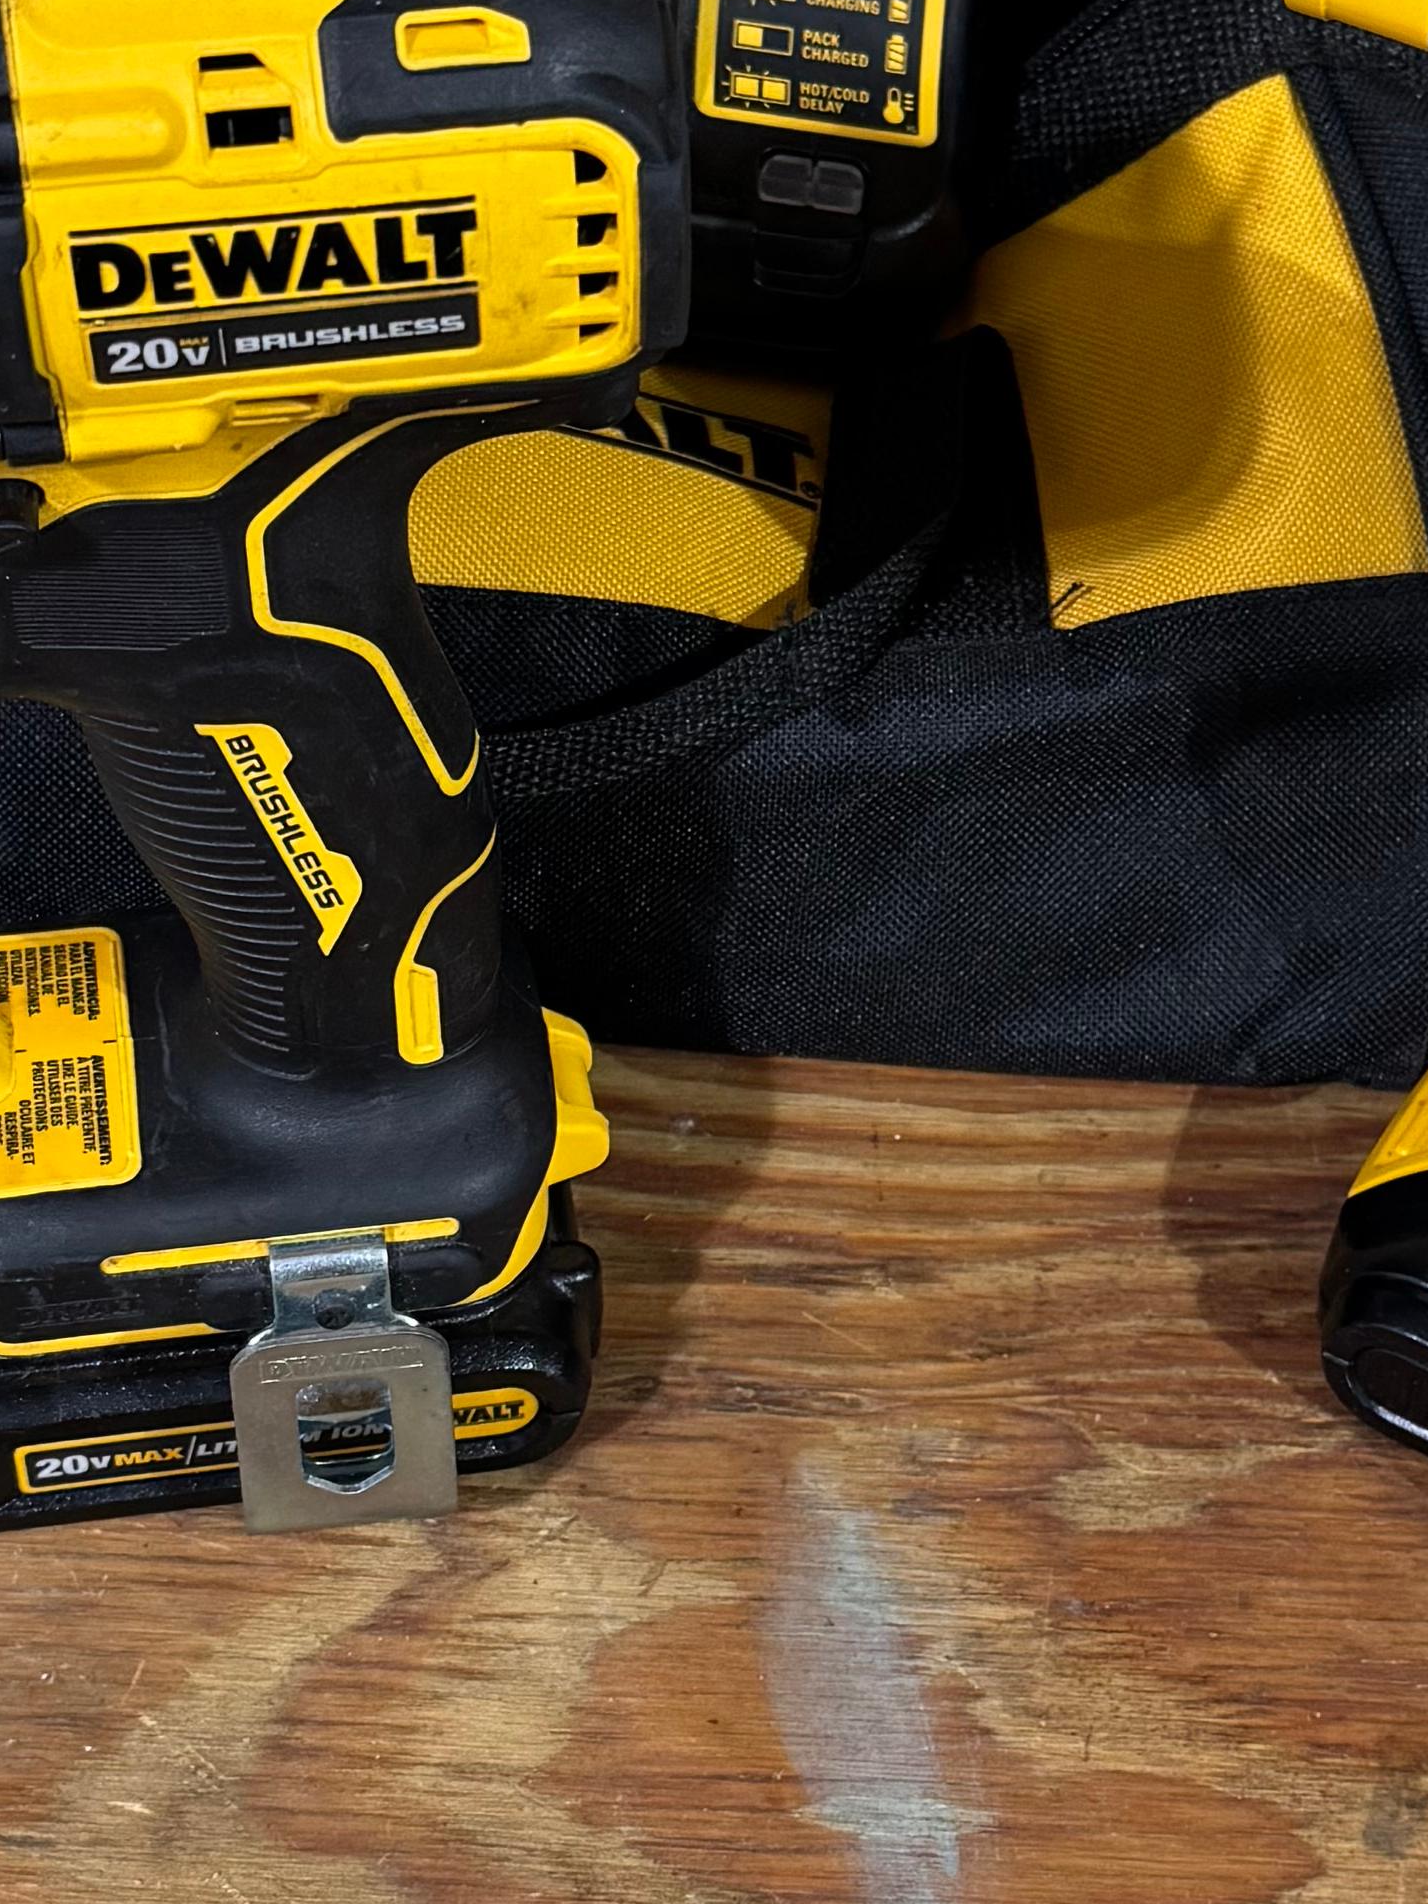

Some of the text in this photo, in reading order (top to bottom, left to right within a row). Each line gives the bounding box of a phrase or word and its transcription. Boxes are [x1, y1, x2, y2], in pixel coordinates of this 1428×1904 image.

[801, 44, 869, 69] CHARGED
[802, 29, 839, 48] PACK
[798, 96, 844, 115] DELAY
[799, 80, 870, 106] HOT/COLD
[70, 209, 476, 310] DEWALT
[235, 314, 465, 354] BRUSHLESS
[225, 735, 344, 909] BRUSHLESS
[29, 1061, 50, 1132] PROTECTIONS
[45, 1059, 63, 1126] UTILISER DES
[61, 1057, 79, 1129] LIRE LE GUIDE.
[76, 1065, 92, 1093] TITRE
[89, 1054, 114, 1165] AVERTISSEMENT:
[2, 1111, 20, 1160] RESPIRA-
[17, 1099, 35, 1165] OCULAIRE ET
[453, 1401, 524, 1426] WALT
[114, 1446, 185, 1468] MAX
